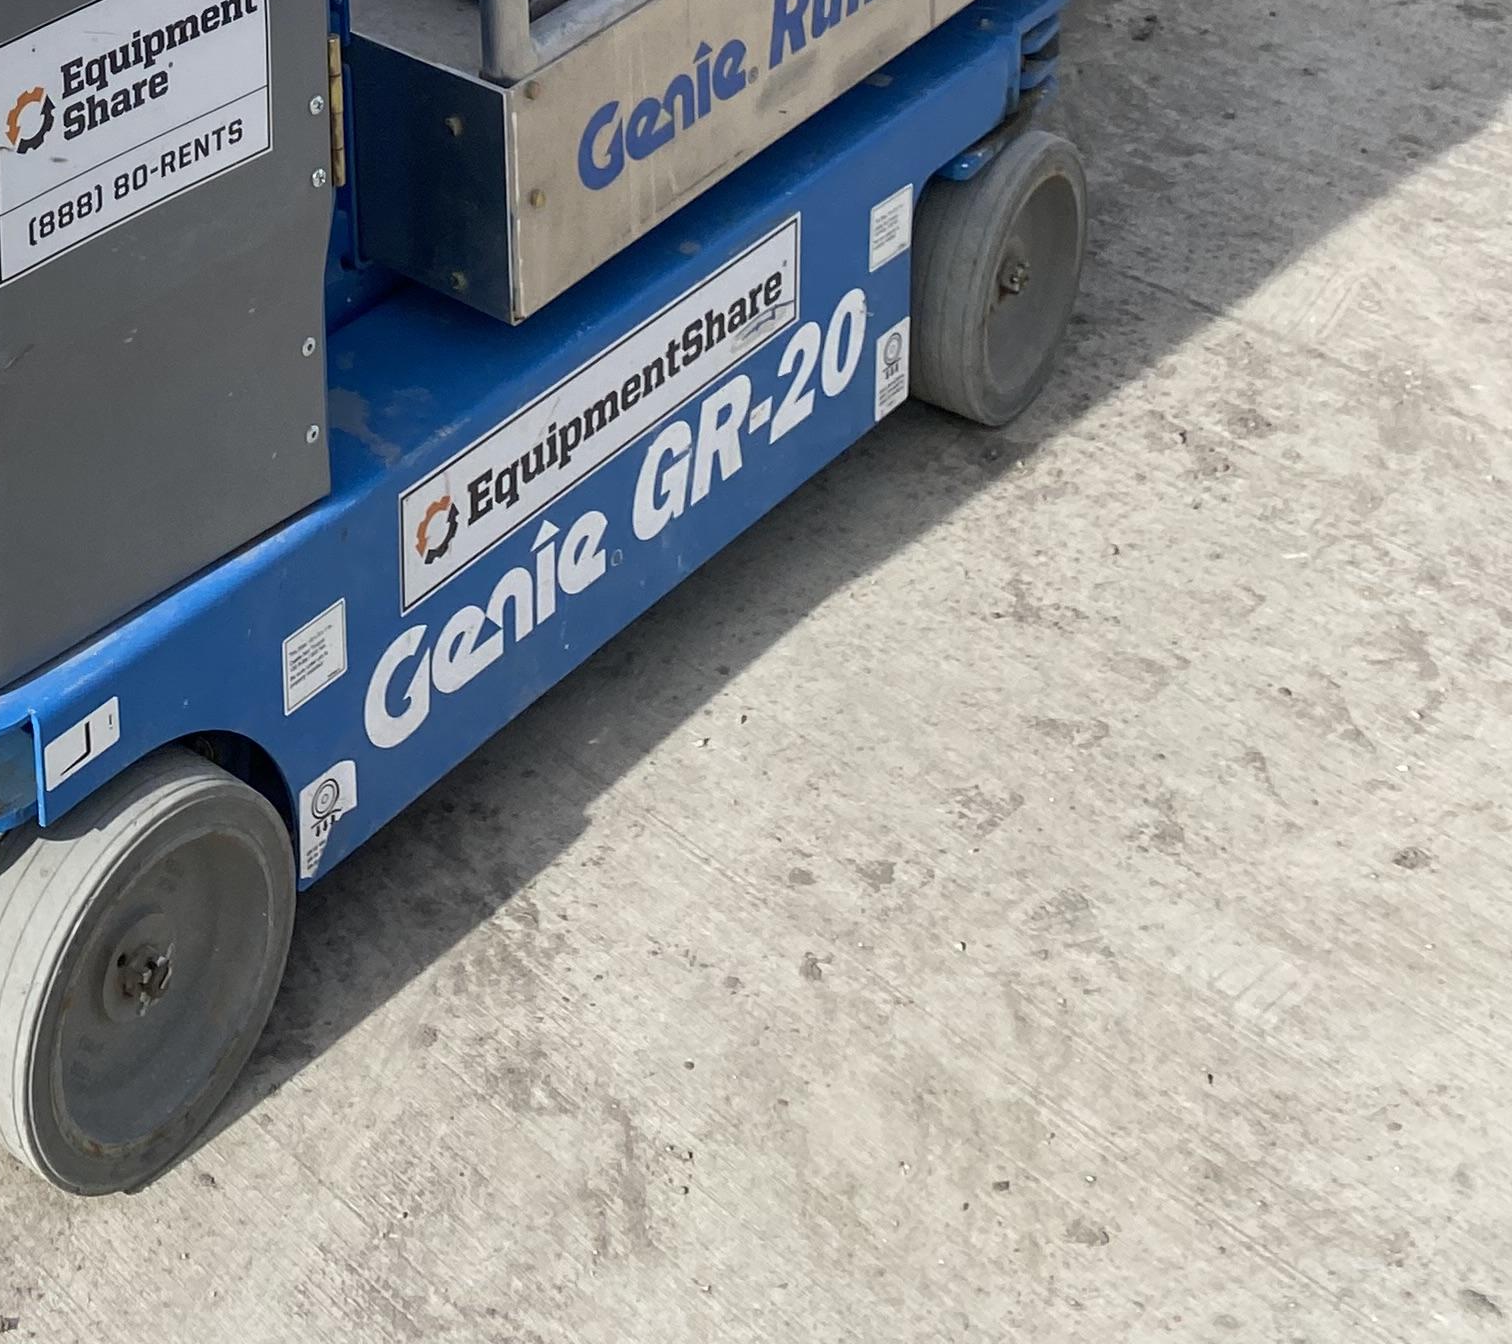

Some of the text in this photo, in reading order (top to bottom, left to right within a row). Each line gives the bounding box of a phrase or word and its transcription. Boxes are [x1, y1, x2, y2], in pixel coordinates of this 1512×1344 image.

[62, 70, 169, 141] Share
[577, 40, 747, 190] Genie
[29, 119, 243, 246] (888) 80-RENTS
[467, 271, 783, 527] EquipmentShare
[364, 288, 866, 749] Genie GR-20
